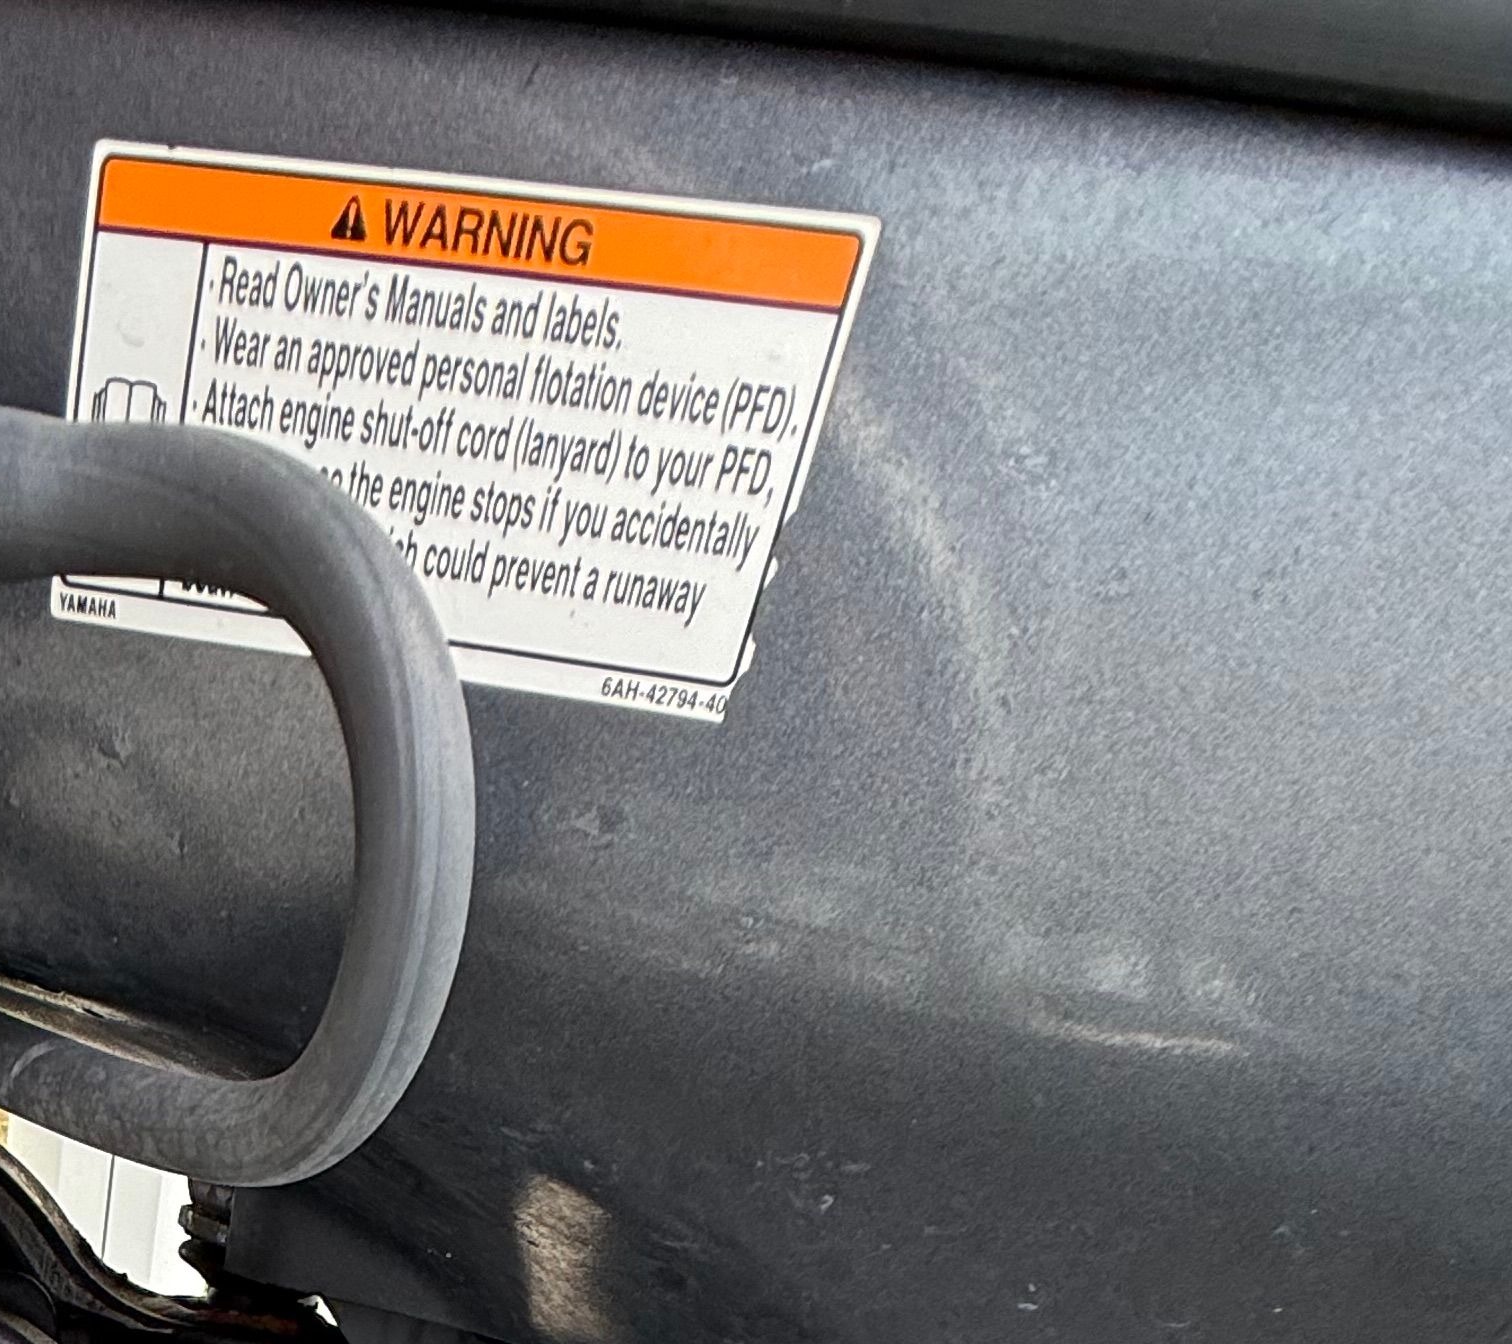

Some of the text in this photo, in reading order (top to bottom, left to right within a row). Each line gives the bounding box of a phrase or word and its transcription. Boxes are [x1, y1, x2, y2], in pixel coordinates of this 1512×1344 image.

[385, 198, 594, 266] WARNING
[218, 256, 621, 350] Read Owner's Manuals and labels.
[215, 316, 798, 442] Wear an approved personal flotation device (PFD).
[202, 378, 773, 508] Attach engine shut-off cord (lanyard) to your PFD,
[348, 460, 384, 508] the
[389, 470, 466, 526] engine
[470, 481, 536, 538] stops
[538, 486, 563, 532] if
[558, 500, 608, 547] you
[611, 500, 760, 572] accidentally
[60, 592, 117, 619] YAMAHA
[423, 539, 490, 584] could
[488, 552, 582, 599] prevent
[583, 567, 599, 601] a
[602, 570, 707, 628] runaway
[601, 677, 728, 714] 6AH-42794-40
